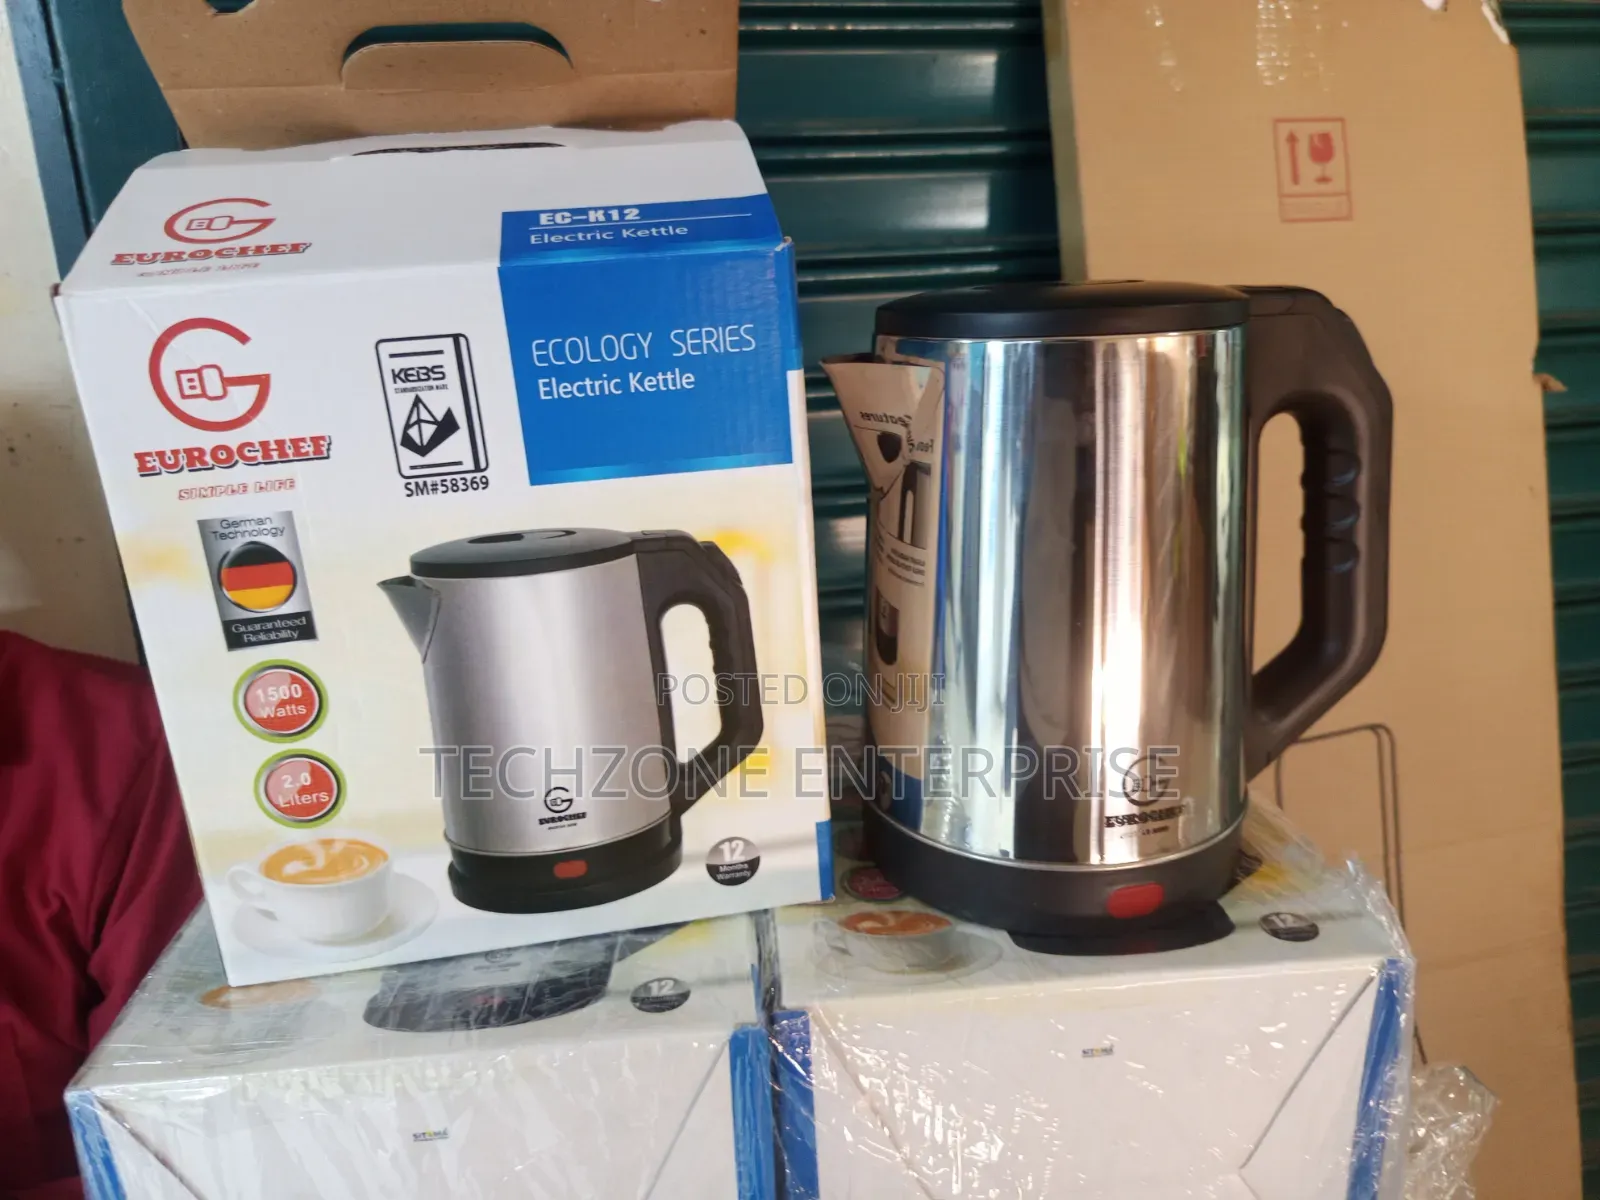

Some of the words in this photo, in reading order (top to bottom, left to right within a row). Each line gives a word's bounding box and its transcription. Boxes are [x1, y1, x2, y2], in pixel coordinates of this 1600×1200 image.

[539, 208, 641, 226] EC-K12
[530, 229, 614, 244] Electric
[622, 225, 689, 238] Kettle
[110, 242, 312, 265] EUROCHEF
[532, 332, 652, 366] ECOLOGY
[670, 324, 756, 357] SERIES
[391, 365, 446, 384] KEBS
[538, 374, 623, 400] Electric
[629, 368, 695, 393] Kettle
[134, 435, 331, 477] EUROCHEF
[178, 483, 248, 500] SIMPLE
[255, 479, 295, 493] LIFE
[404, 475, 489, 497] SM#58369
[220, 517, 273, 529] German
[212, 526, 286, 540] Technology
[232, 616, 307, 633] Guaranteed
[243, 629, 300, 643] Reliability
[256, 683, 303, 703] 1500
[261, 704, 307, 718] Watts
[281, 772, 312, 788] 2.0
[278, 791, 330, 807] Liters
[718, 840, 746, 862] 12
[715, 870, 751, 880] Warranty
[719, 863, 749, 872] Months
[648, 979, 675, 997] 12
